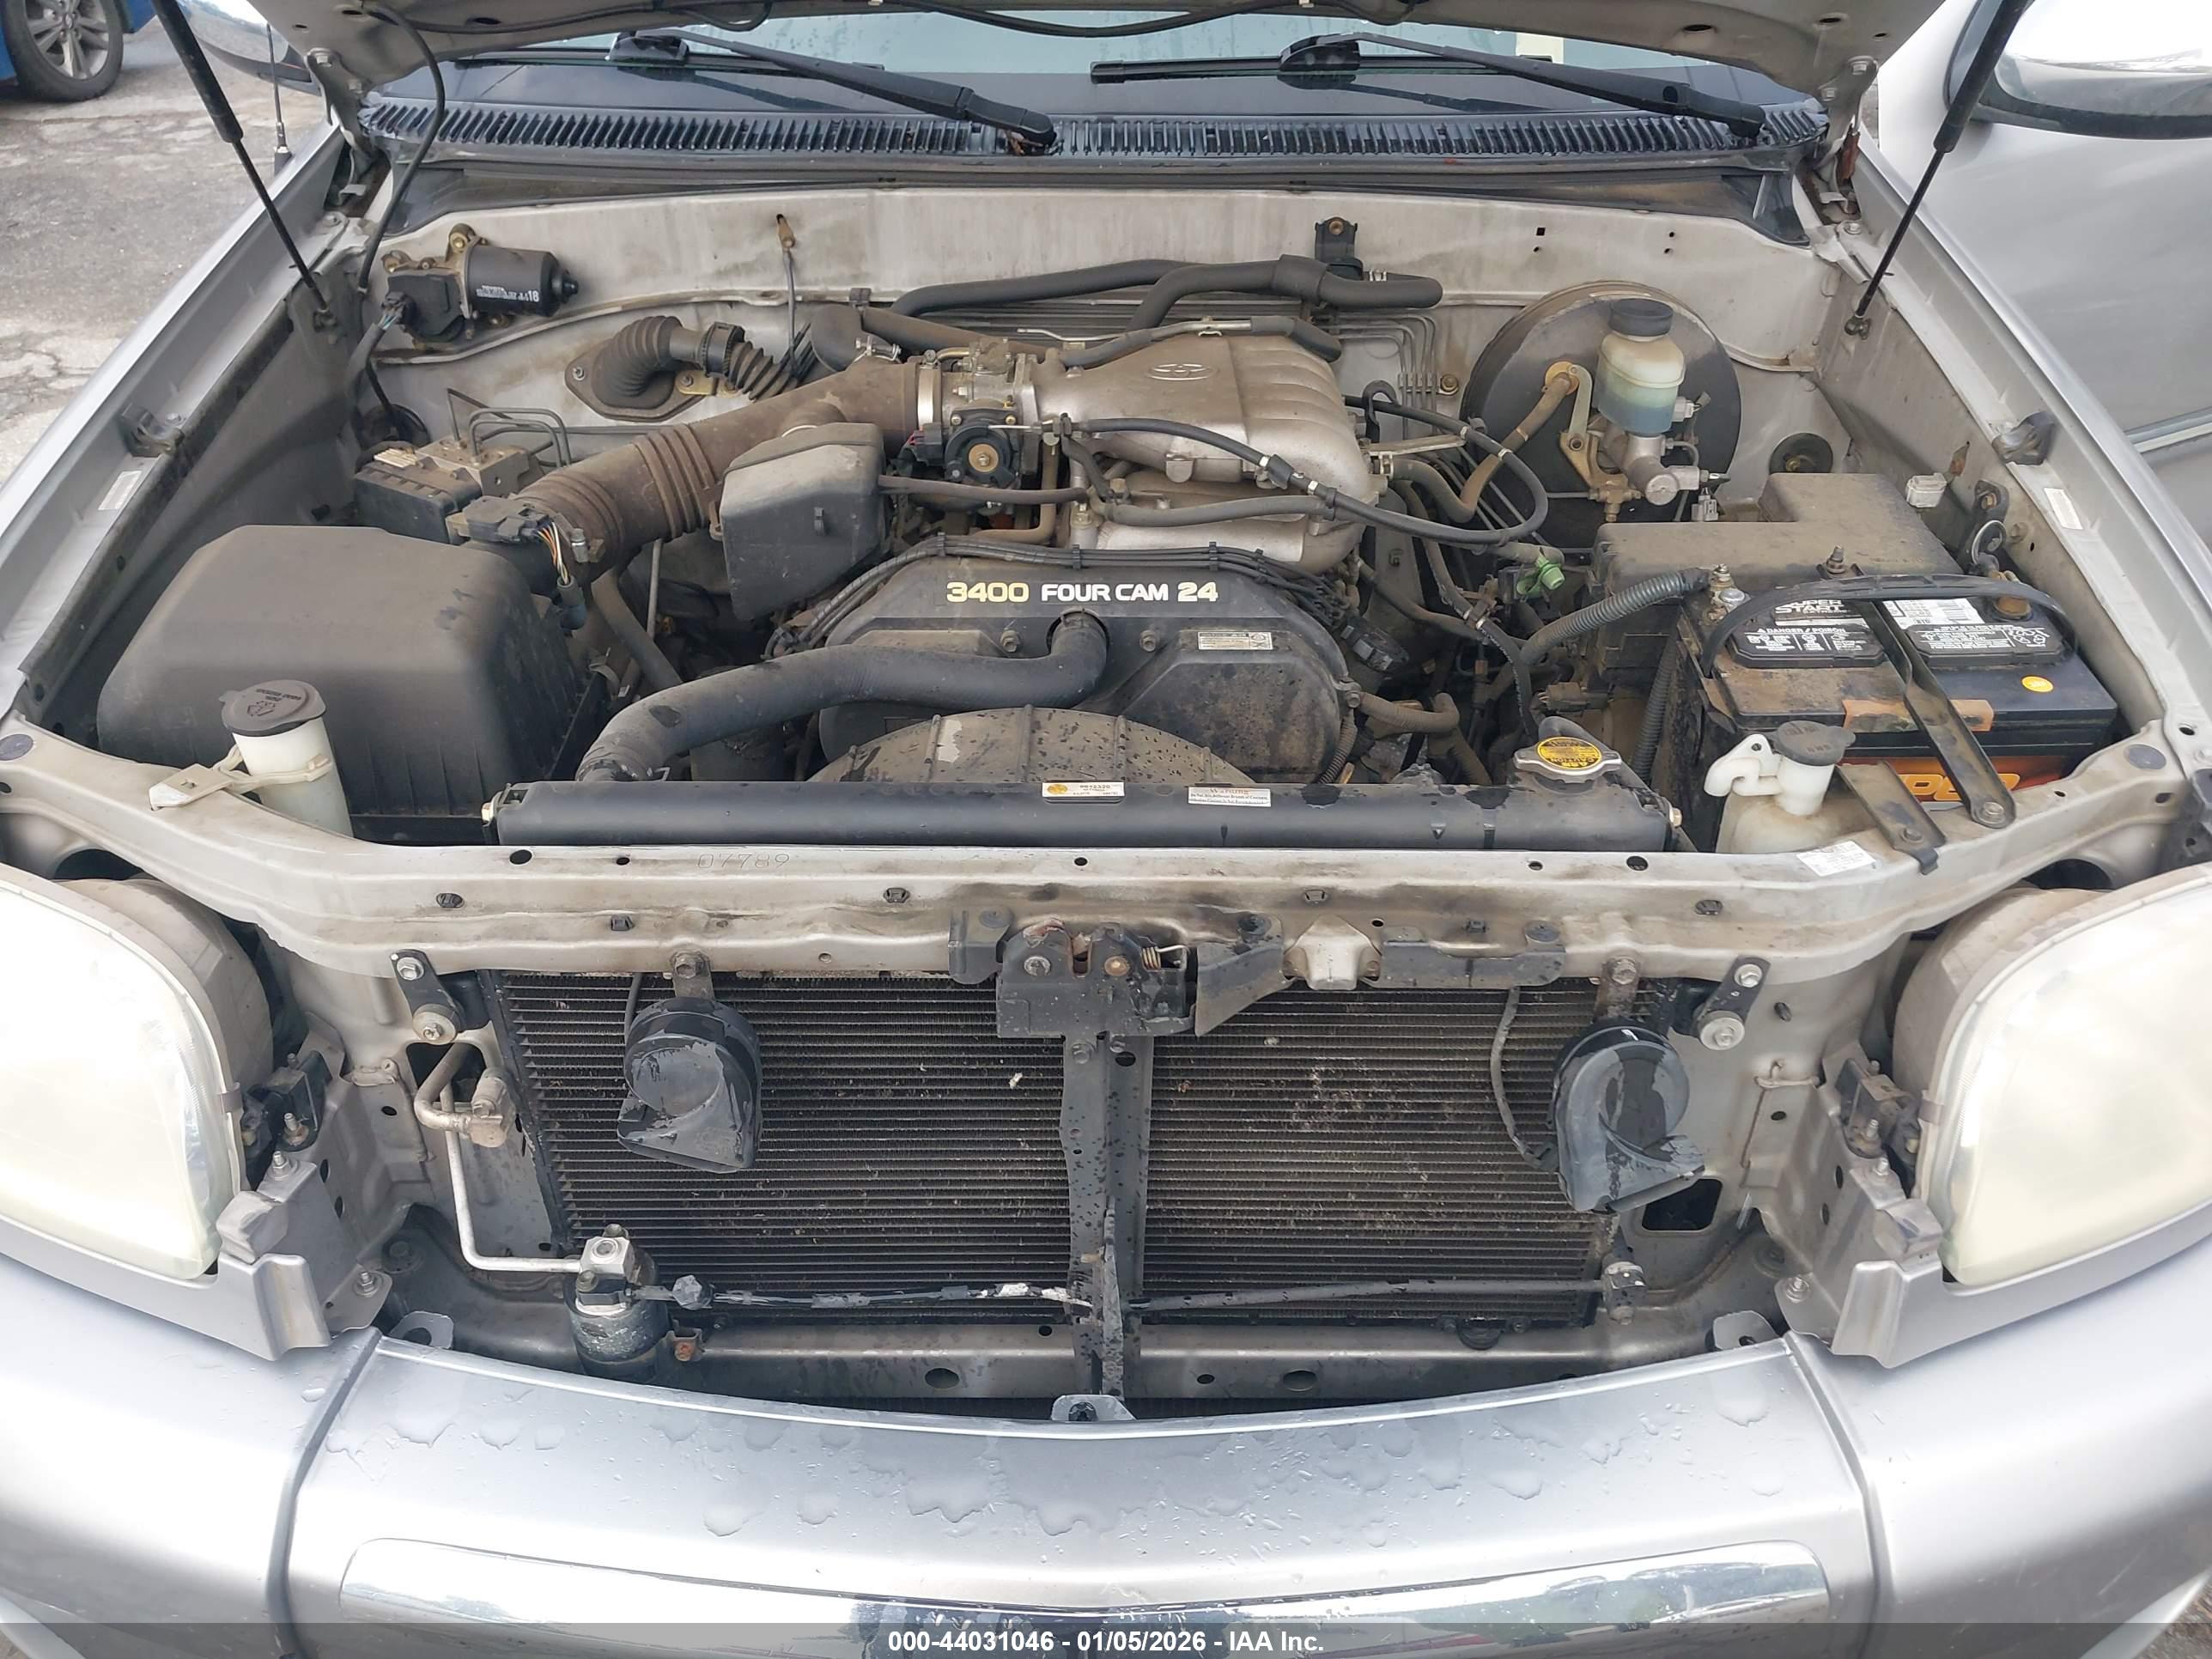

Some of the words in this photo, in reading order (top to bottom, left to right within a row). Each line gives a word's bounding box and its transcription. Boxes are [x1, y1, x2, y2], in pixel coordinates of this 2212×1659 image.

[946, 581, 1029, 602] 3400
[1041, 584, 1111, 601] FOUR
[1115, 584, 1169, 601] CAM
[1177, 581, 1218, 602] 24
[1775, 604, 1844, 614] START
